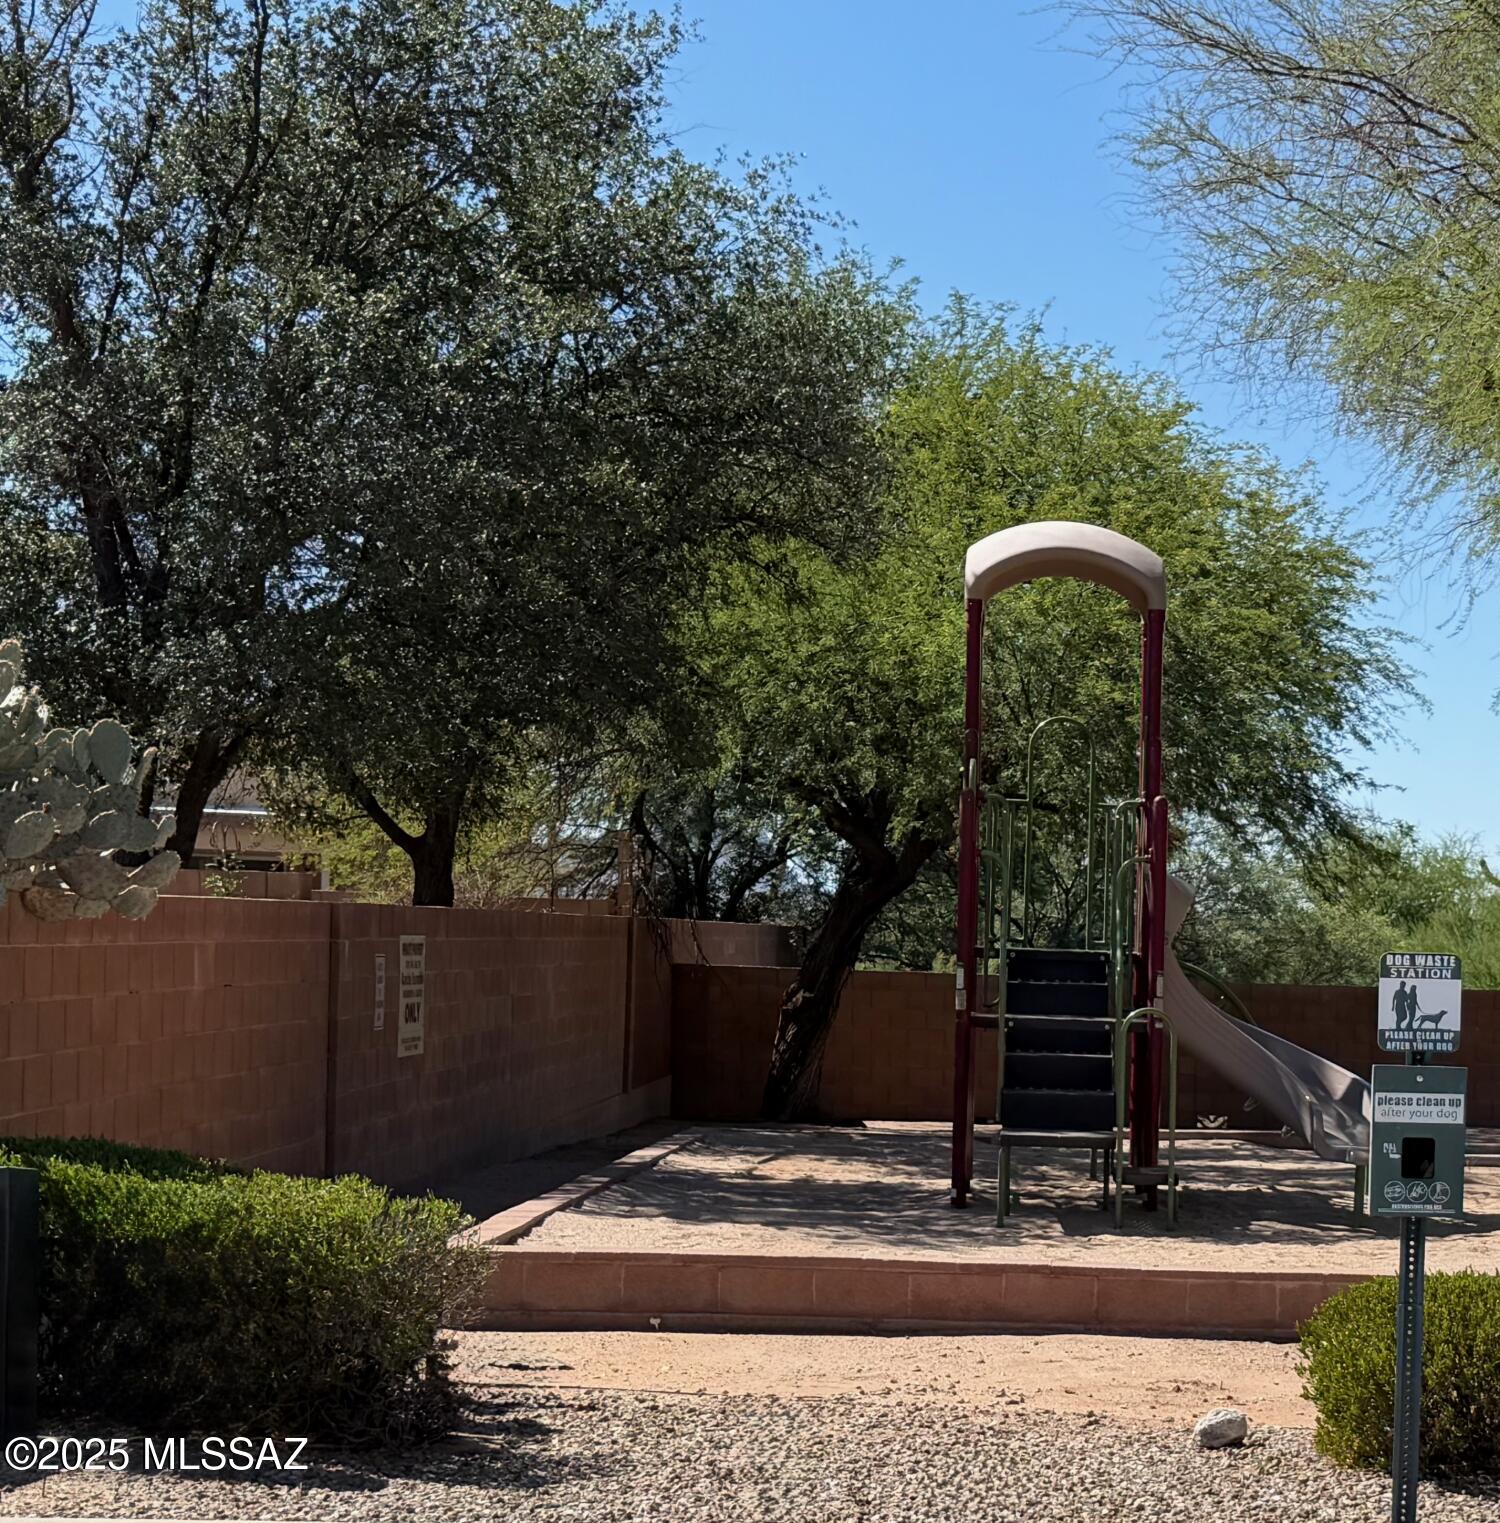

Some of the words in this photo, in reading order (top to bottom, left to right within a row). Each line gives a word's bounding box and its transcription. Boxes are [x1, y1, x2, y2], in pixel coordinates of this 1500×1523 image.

[1386, 954, 1410, 965] DOG
[1415, 955, 1456, 967] WASTE
[1390, 968, 1451, 978] STATION
[405, 1002, 421, 1024] ONLY
[1385, 1031, 1413, 1039] PLEASE
[1416, 1031, 1441, 1040] CLEAN
[1443, 1032, 1454, 1040] UP
[1386, 1041, 1410, 1050] AFTER
[1412, 1042, 1434, 1050] YOUR
[1436, 1042, 1453, 1051] DOG
[1377, 1096, 1413, 1108] please
[1416, 1096, 1446, 1107] clean
[1448, 1098, 1462, 1108] up
[1380, 1108, 1406, 1117] after
[1409, 1109, 1433, 1120] your
[1436, 1109, 1458, 1121] dog
